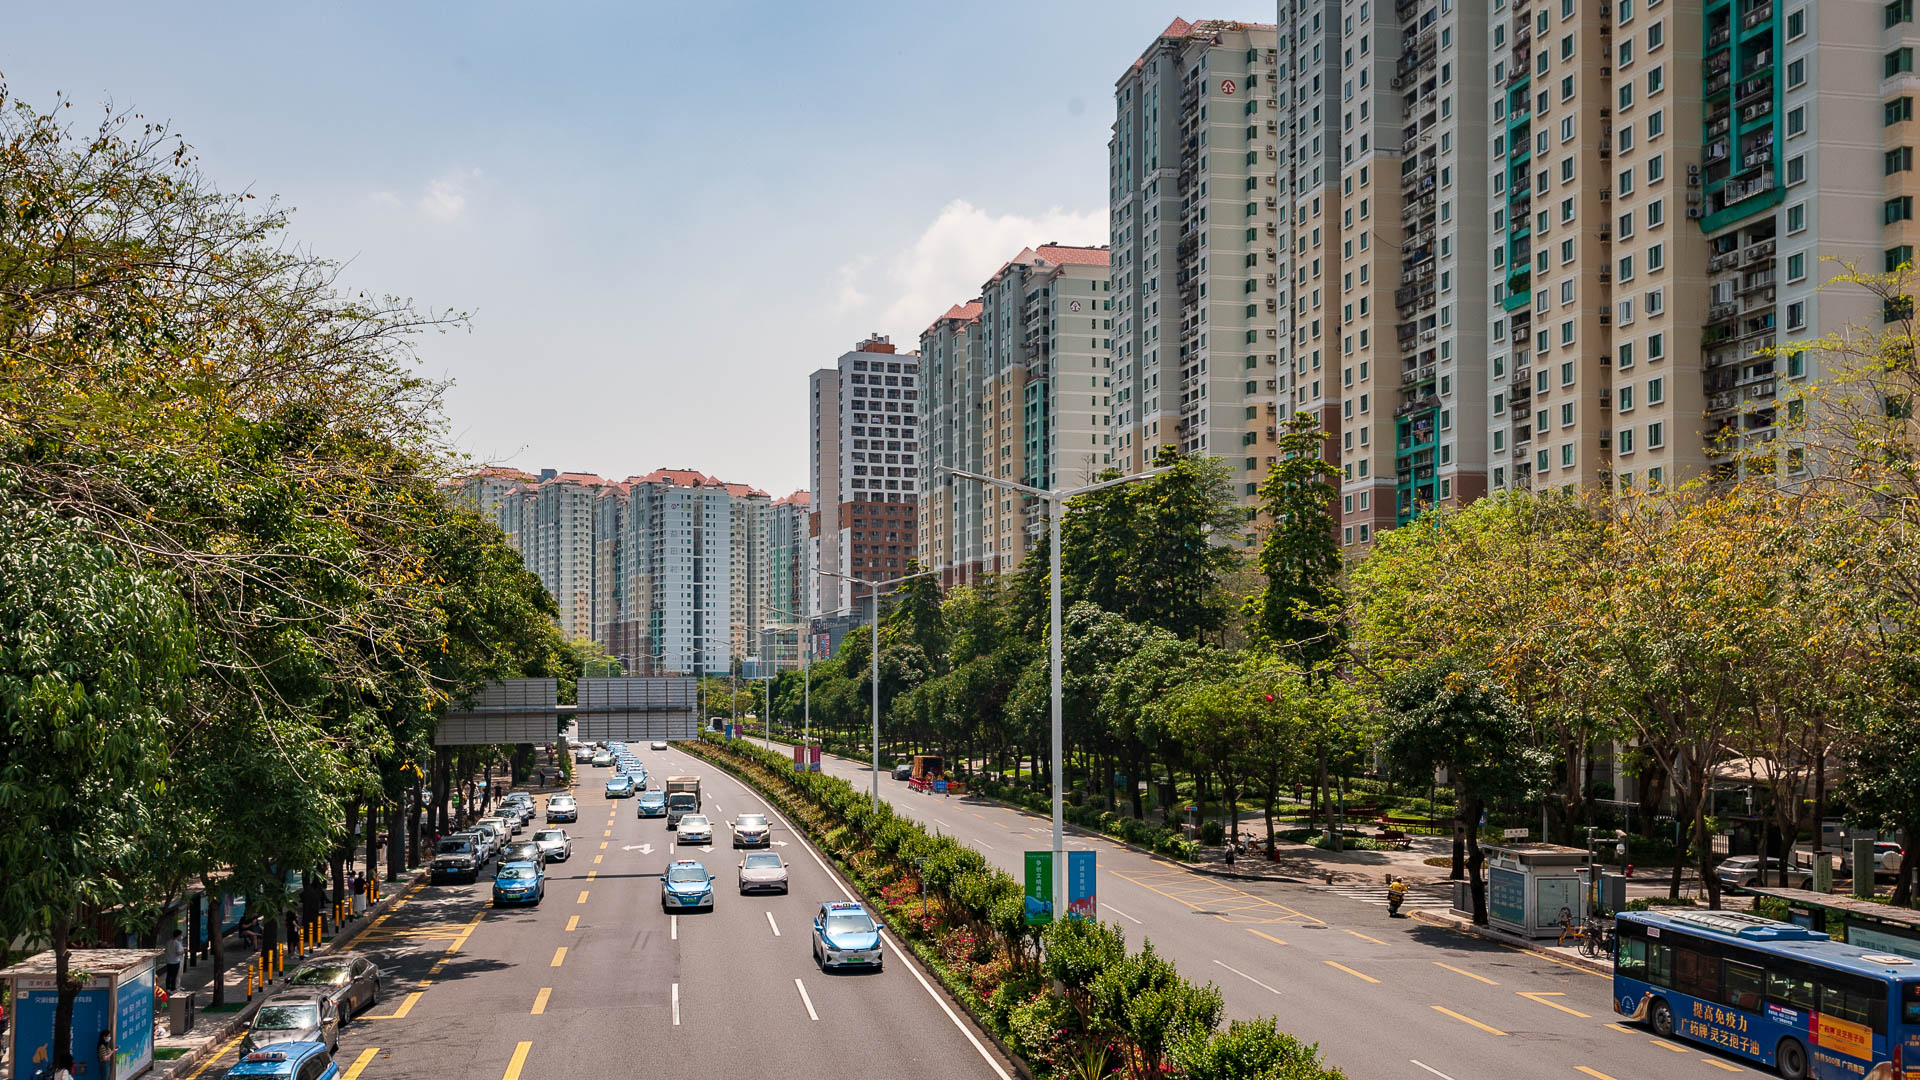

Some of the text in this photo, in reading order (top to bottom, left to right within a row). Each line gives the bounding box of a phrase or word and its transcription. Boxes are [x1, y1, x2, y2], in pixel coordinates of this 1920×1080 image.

[1693, 1001, 1748, 1032] 提高免疫力
